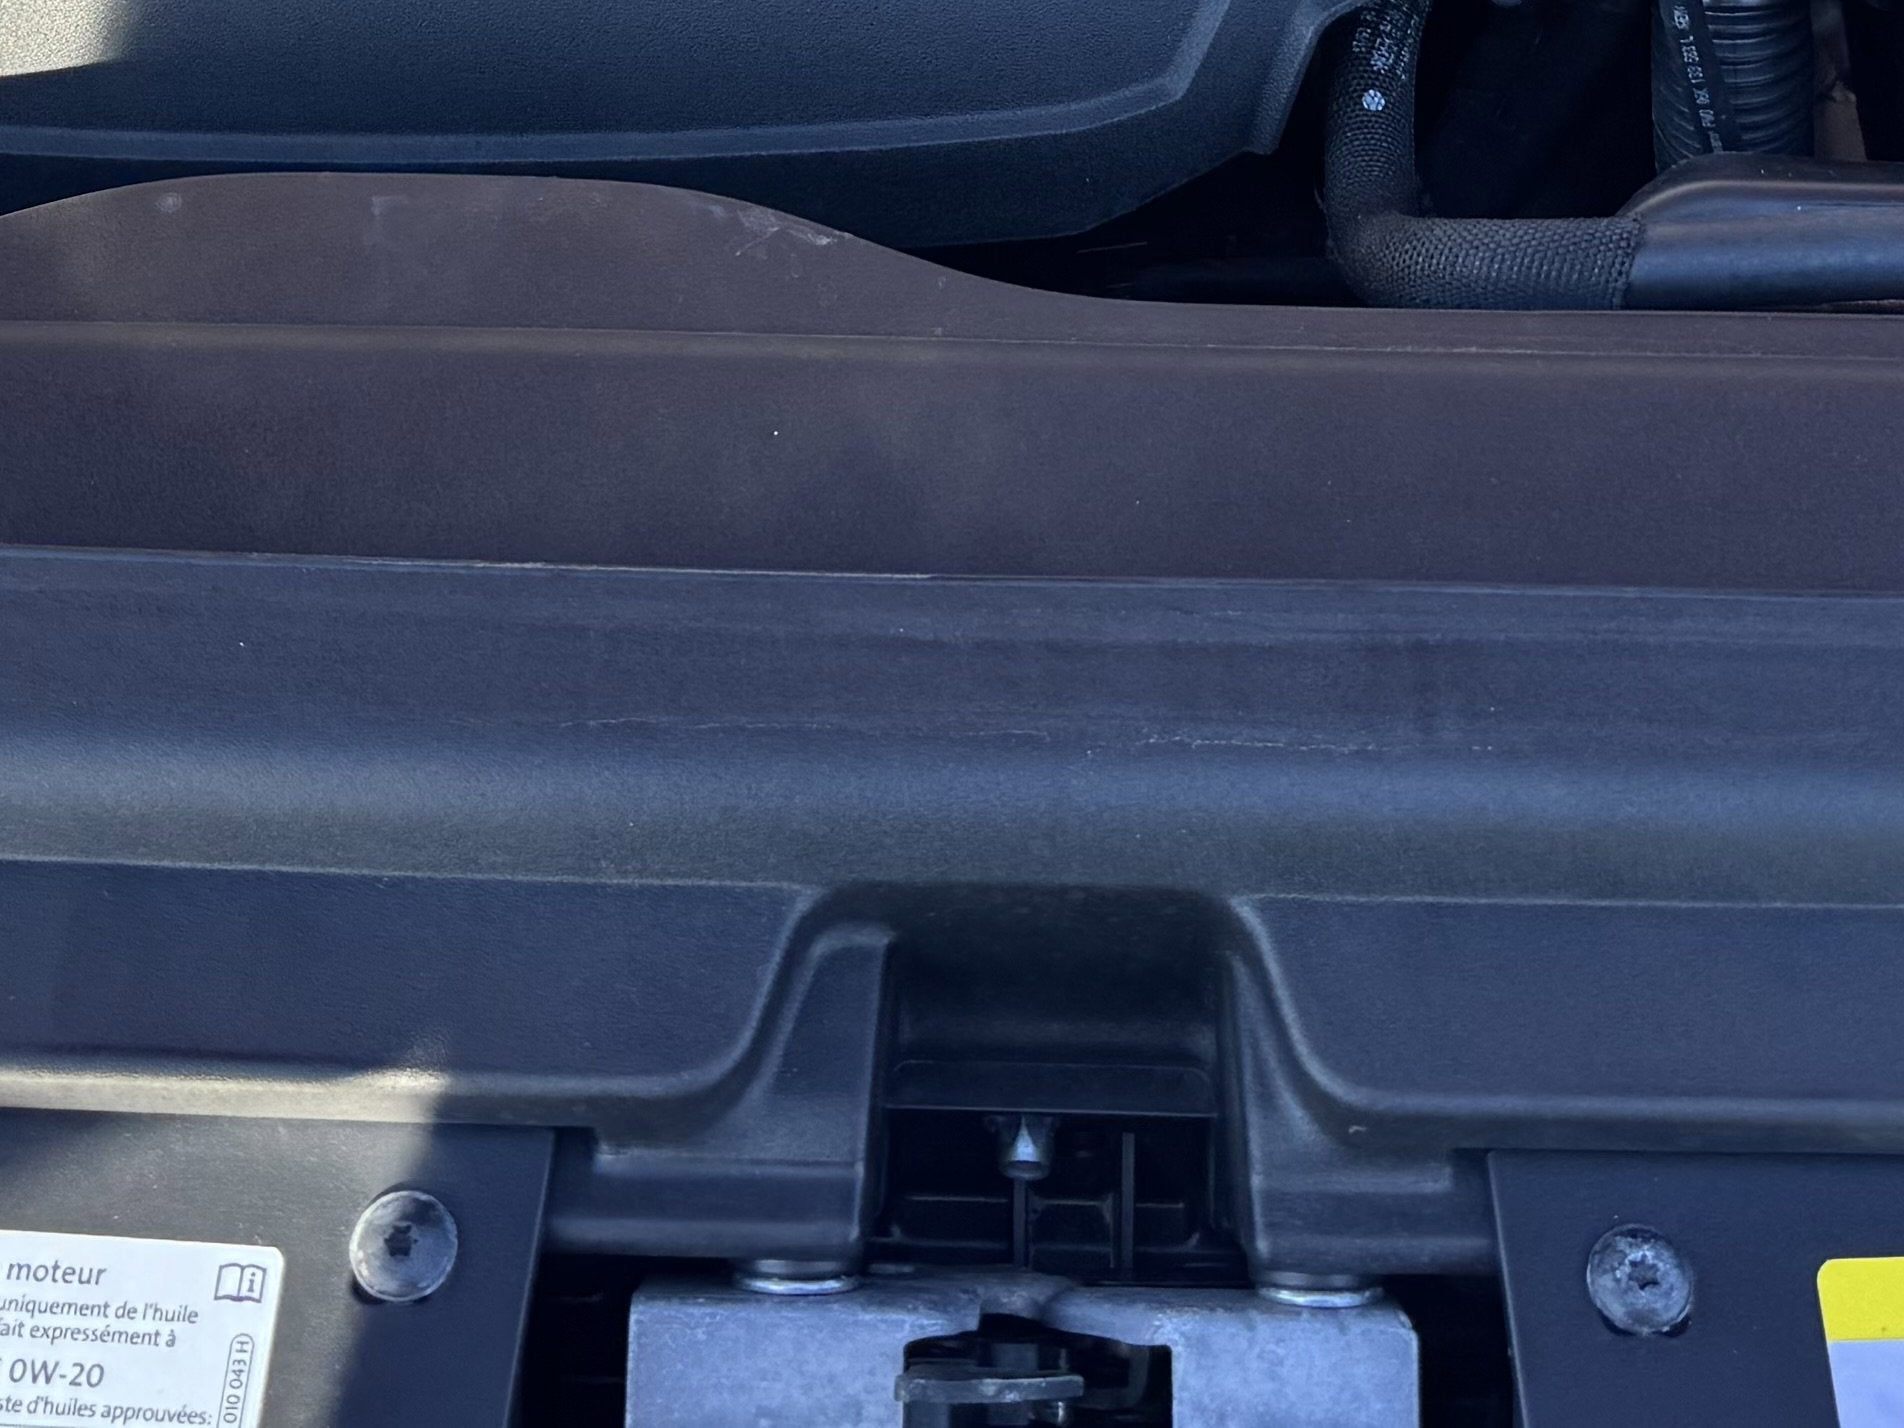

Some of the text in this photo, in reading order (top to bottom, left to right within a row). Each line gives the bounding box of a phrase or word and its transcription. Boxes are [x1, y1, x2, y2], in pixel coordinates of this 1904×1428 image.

[5, 1259, 108, 1287] moteur
[115, 1300, 139, 1321] de
[141, 1301, 200, 1326] l'huile
[29, 1322, 161, 1350] expressément
[164, 1328, 178, 1348] à
[8, 1360, 106, 1390] 0W-20
[228, 1357, 246, 1391] 043
[25, 1393, 96, 1420] d'huiles
[99, 1396, 214, 1428] approuvées:
